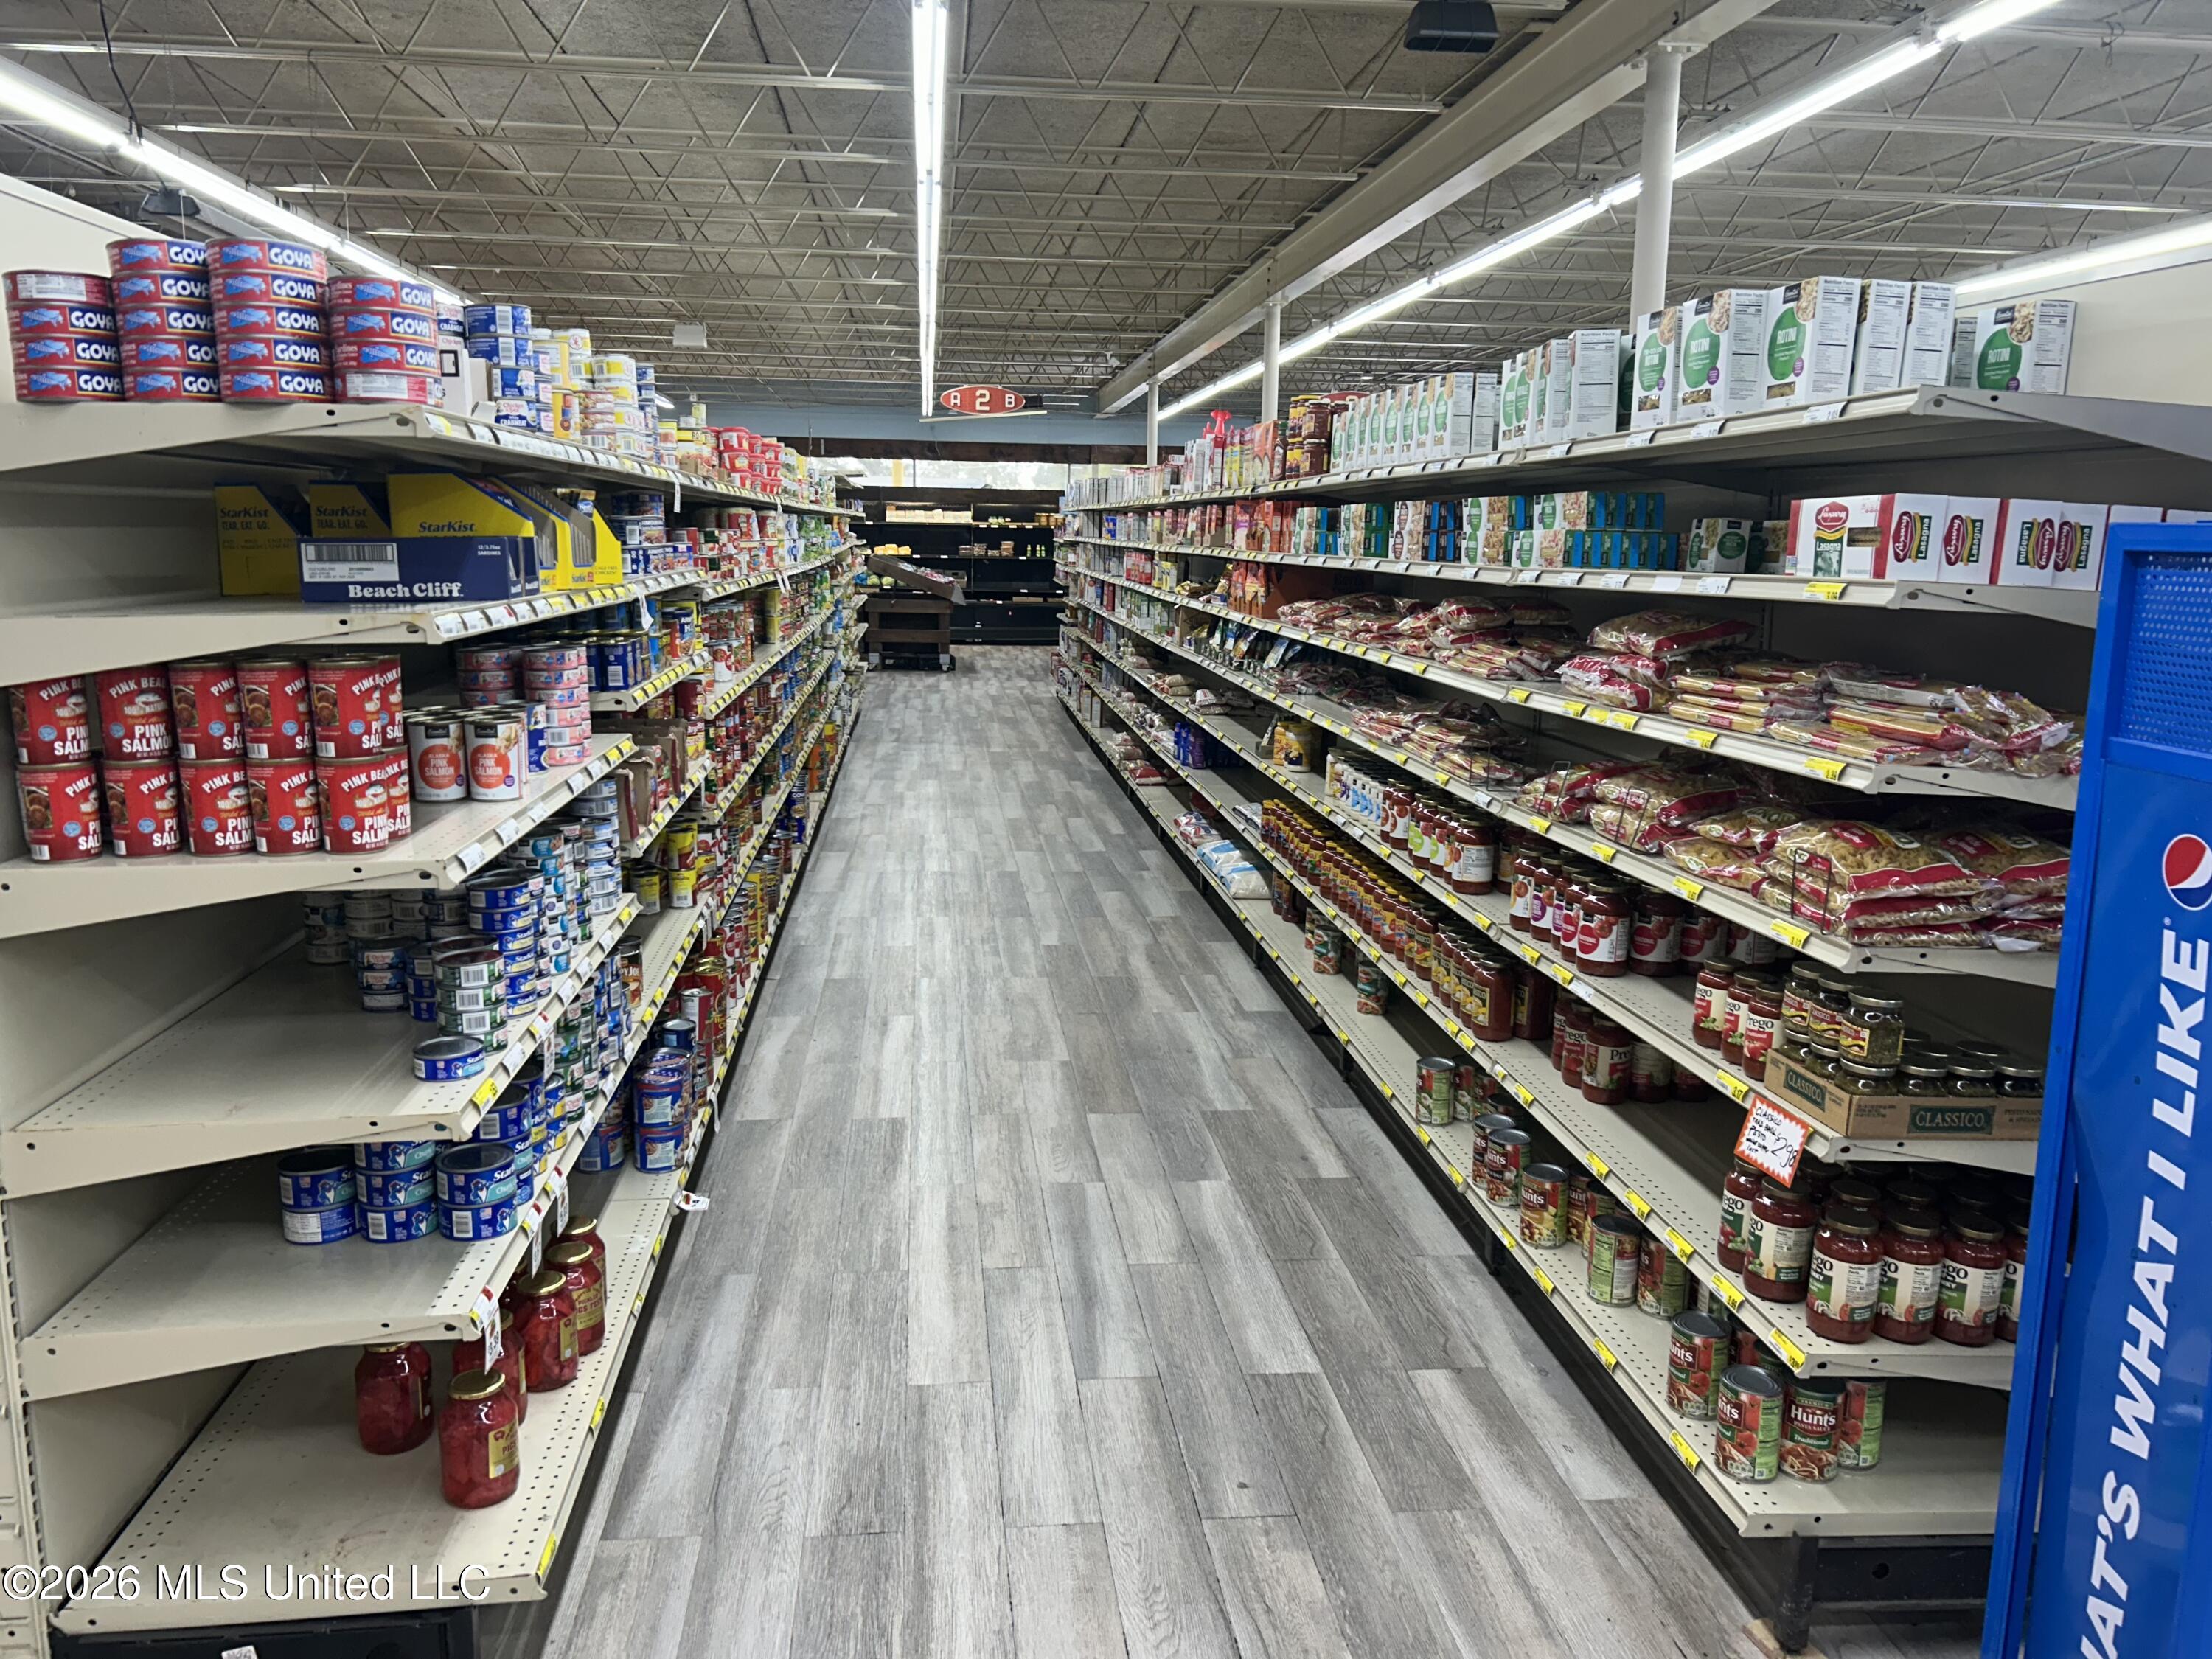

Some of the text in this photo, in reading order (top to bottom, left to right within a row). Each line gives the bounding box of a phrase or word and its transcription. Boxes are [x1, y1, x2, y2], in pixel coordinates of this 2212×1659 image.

[170, 247, 207, 263] GOY
[269, 247, 314, 270] GOYA
[273, 279, 316, 300] GOYA
[401, 287, 433, 307] GOYA
[71, 311, 114, 329] GOYA
[276, 310, 319, 331] GOYA
[392, 317, 431, 337] GOYA
[1776, 327, 1797, 344] ROTINI
[77, 342, 119, 360] GOYA
[188, 344, 218, 361] GOY
[275, 344, 320, 363] GOYA
[1691, 338, 1710, 354] ROTINI
[406, 349, 437, 369] GOYA
[1988, 347, 2010, 364] ROTINI
[79, 374, 122, 392] GOYA
[184, 375, 219, 392] GOY
[280, 375, 324, 394] GOYA
[950, 389, 1015, 411] A 2 B
[500, 419, 527, 427] CRABMEAT
[221, 507, 268, 518] StarKist
[316, 507, 367, 516] StarKist
[1818, 507, 1847, 523] Luxury
[418, 521, 475, 532] StarKist
[1894, 513, 1911, 558] Luxury
[1918, 517, 1930, 557] Lasagna
[1946, 517, 1964, 560] Luxury
[1969, 521, 1982, 560] Lasagna
[2019, 523, 2031, 563] Lasagna
[1817, 540, 1841, 553] Lasagna
[2077, 527, 2090, 567] Lasagna
[348, 582, 462, 598] Beach Cliff
[39, 681, 69, 700] PINK
[110, 679, 138, 698] PINK
[210, 676, 237, 697] PINK
[285, 676, 307, 697] PINK
[352, 676, 375, 696] PINK
[66, 726, 88, 740] PIN
[134, 723, 167, 738] PINK
[54, 740, 89, 756] SALM
[362, 735, 381, 749] SAL
[425, 767, 455, 776] SALMON
[431, 759, 448, 767] PINK
[474, 767, 503, 776] SALMON
[479, 759, 496, 767] PINK
[65, 777, 91, 798] PINK
[140, 773, 167, 795] PINK
[202, 773, 232, 793] PINK
[280, 771, 307, 793] PINK
[341, 771, 369, 793] PINK
[228, 818, 252, 832] PIN
[215, 832, 253, 846] SALM
[352, 830, 389, 844] SALM
[1787, 1072, 1822, 1103] CLASSICO
[1756, 1107, 1782, 1126] CLASSICO
[1916, 1110, 1985, 1127] CLASSICO
[2080, 928, 2210, 1659] AT'S WHAT I LIKE
[1790, 1404, 1837, 1427] Hunt's
[1793, 1434, 1830, 1447] Traditional
